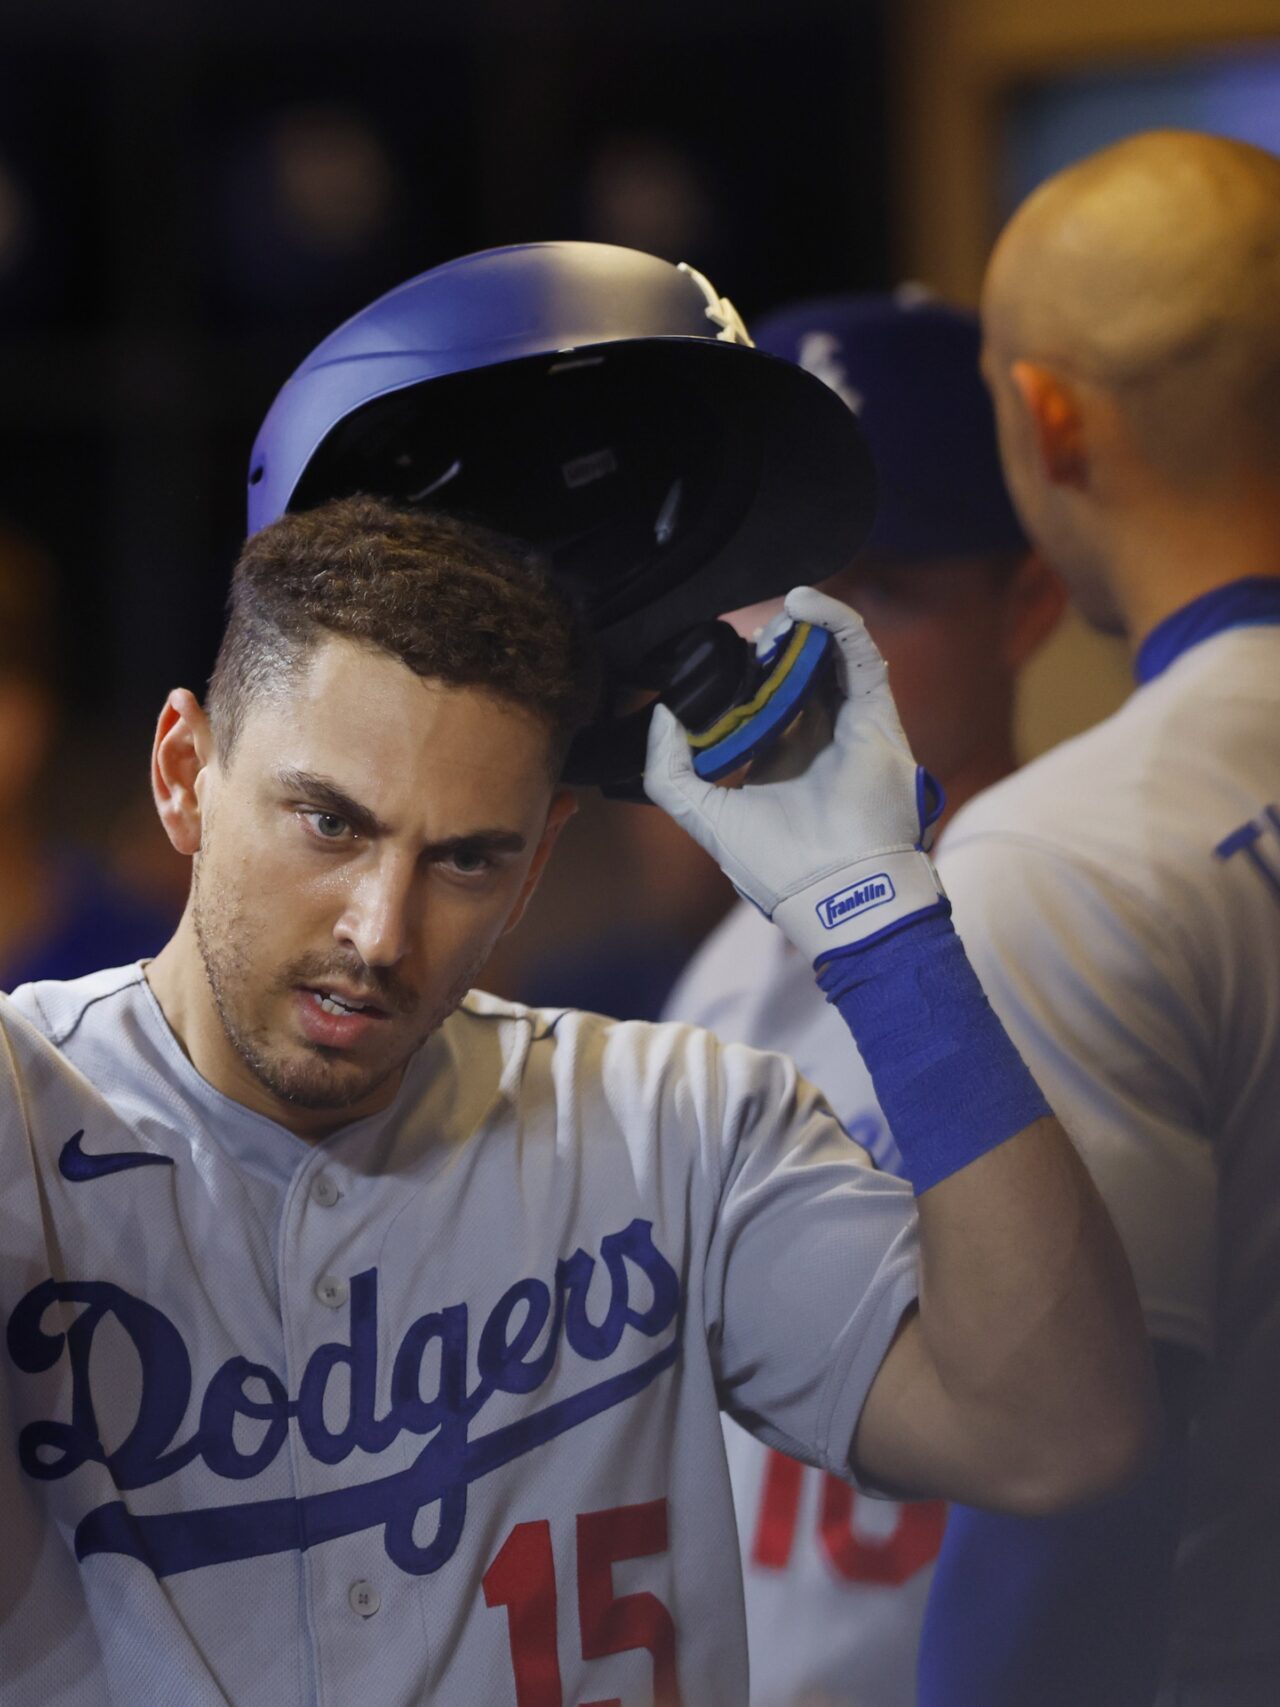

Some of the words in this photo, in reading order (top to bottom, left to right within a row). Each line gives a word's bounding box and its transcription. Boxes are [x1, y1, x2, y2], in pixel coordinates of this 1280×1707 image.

[825, 883, 886, 925] Franklin
[6, 1218, 681, 1576] Dodgers
[481, 1497, 685, 1707] 15
